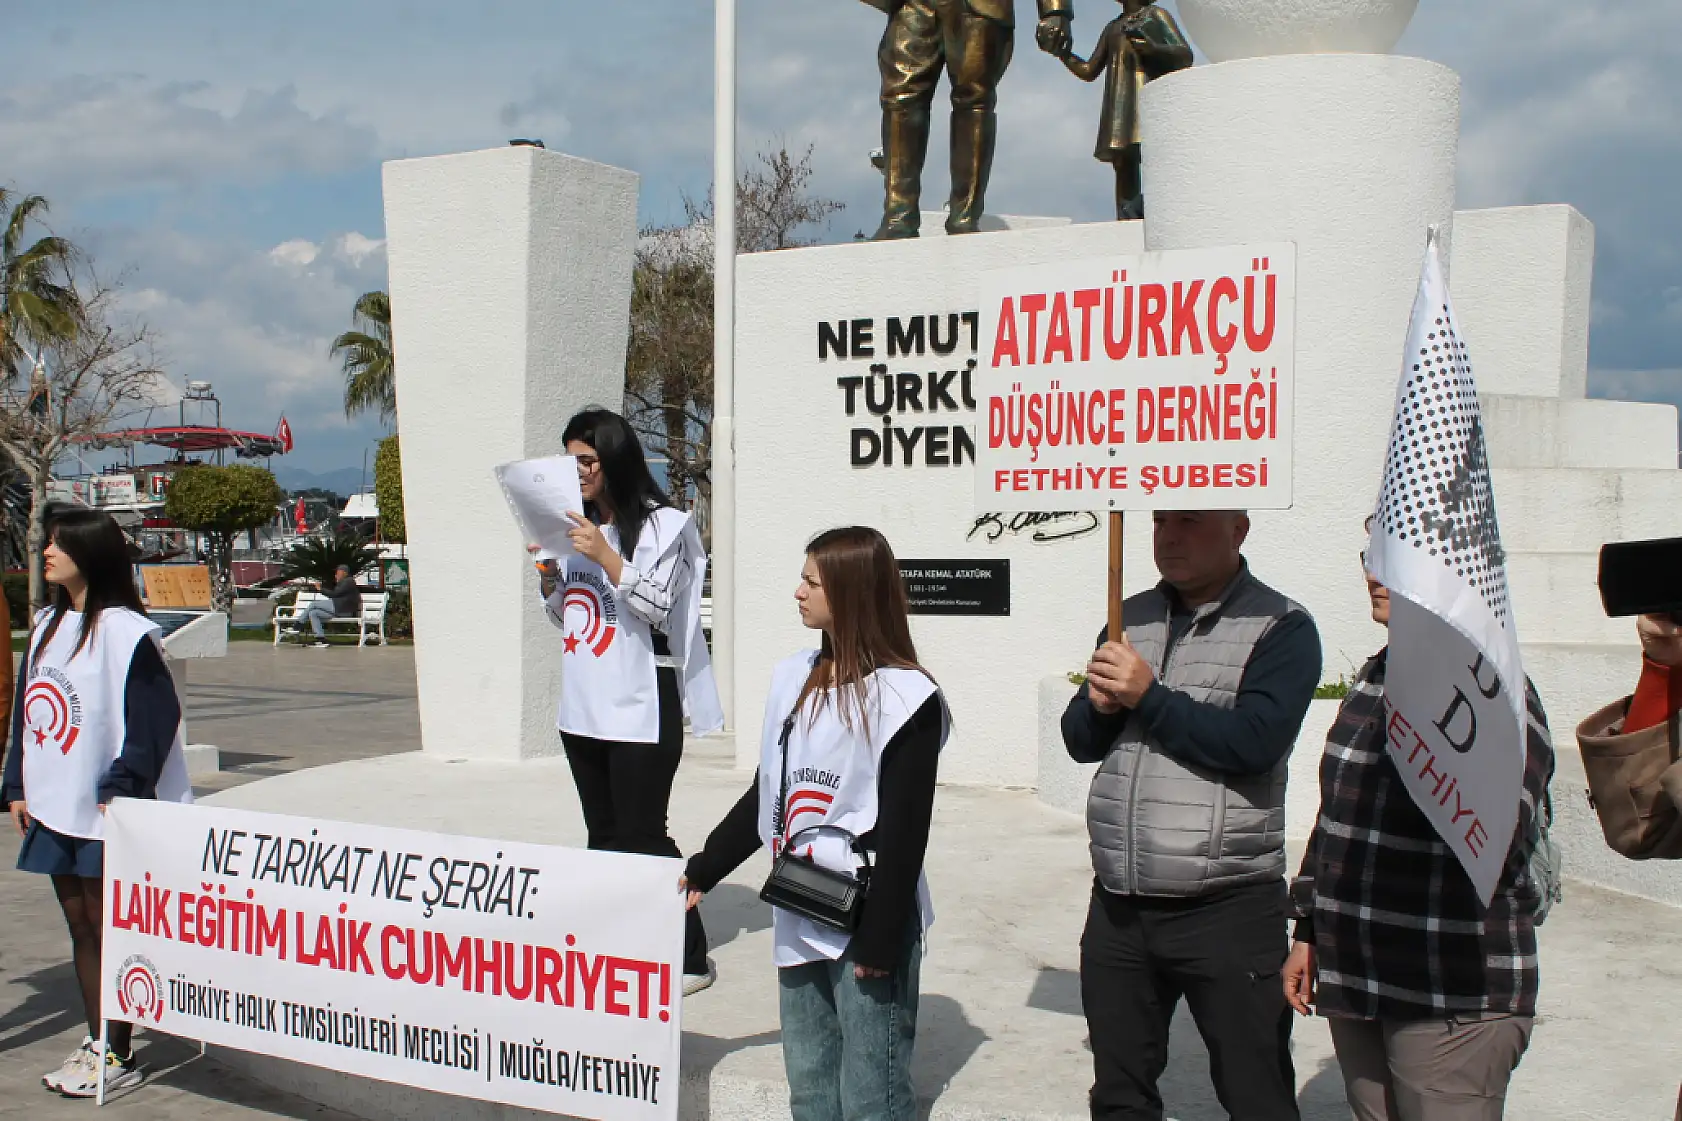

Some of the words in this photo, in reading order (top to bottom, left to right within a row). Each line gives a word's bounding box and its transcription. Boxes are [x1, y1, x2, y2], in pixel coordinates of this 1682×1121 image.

[818, 318, 875, 359] NE
[991, 256, 1278, 378] ATATÜRKÇÜ
[988, 381, 1126, 466] DÜŞÜNCE
[1135, 364, 1278, 444] DERNEĞİ
[994, 457, 1129, 492] FETHİYE
[1139, 457, 1268, 495] ŞUBESİ
[955, 568, 993, 579] ATATÜRK
[201, 827, 246, 877] NE
[251, 828, 374, 893] TARİKAT
[370, 850, 417, 903] NE
[421, 853, 540, 920] ŞERİAT:
[112, 871, 174, 939] LAİK
[179, 881, 287, 961] EĞİTİM
[295, 902, 375, 975] LAİK
[380, 924, 671, 1023] CUMHURİYET!
[168, 973, 230, 1024] TÜRKİYE
[236, 992, 277, 1033] HALK
[282, 1001, 398, 1057] TEMSİLCİLERİ
[403, 1024, 480, 1072] MECLİSİ
[499, 1038, 660, 1105] MUĞLA/FETHİYE
